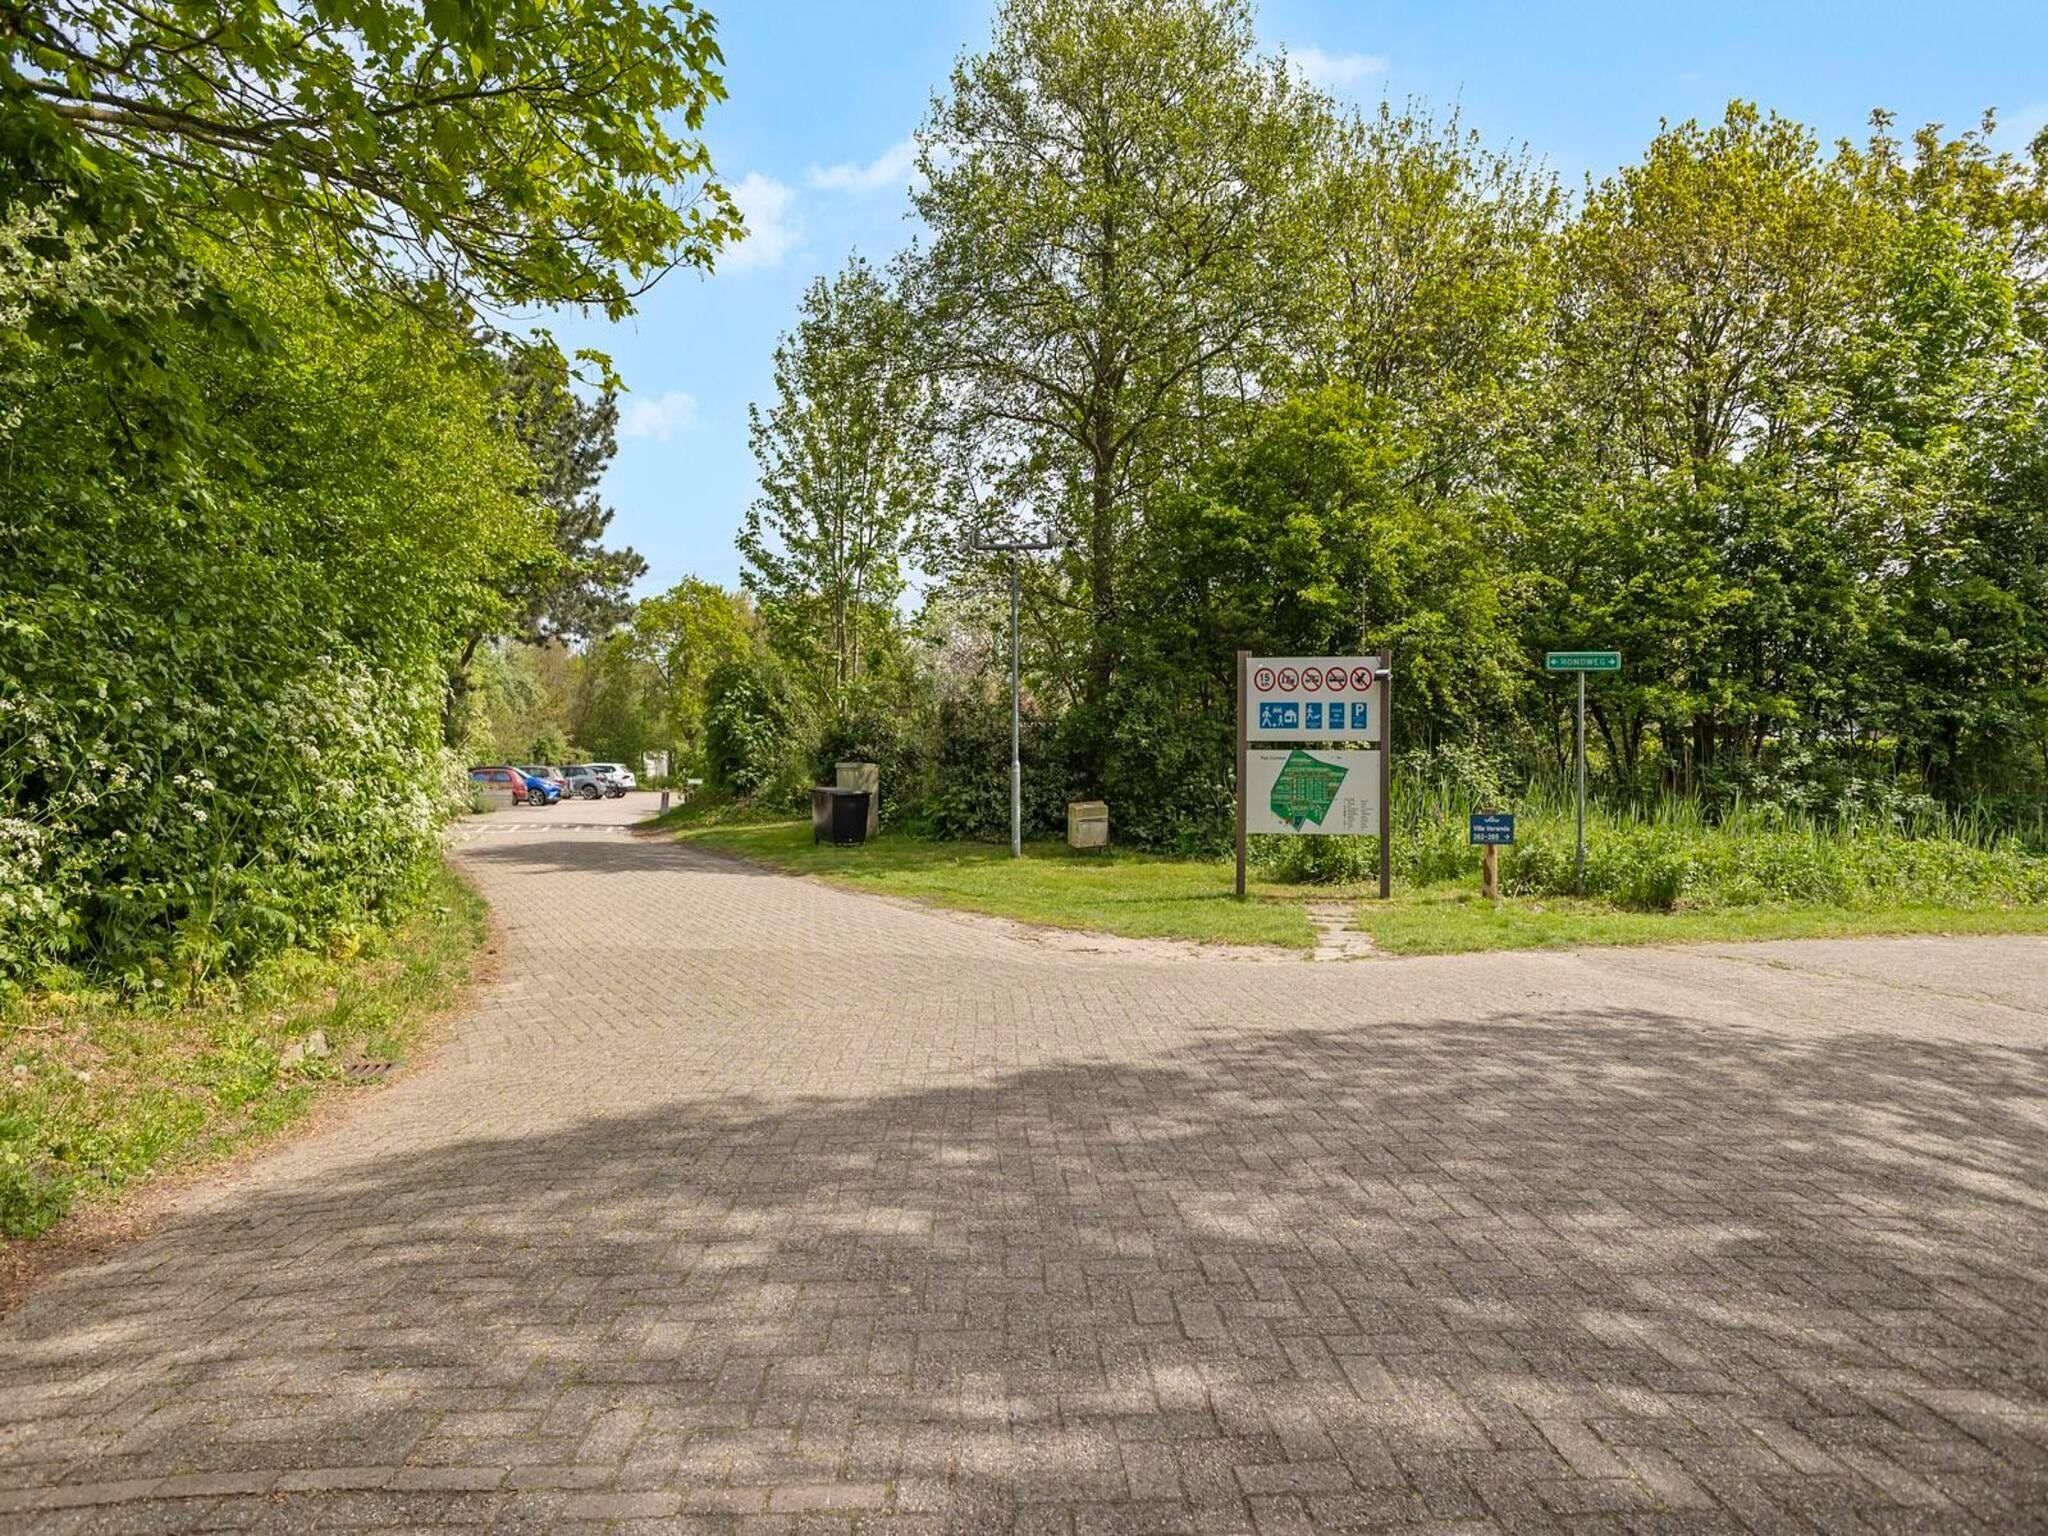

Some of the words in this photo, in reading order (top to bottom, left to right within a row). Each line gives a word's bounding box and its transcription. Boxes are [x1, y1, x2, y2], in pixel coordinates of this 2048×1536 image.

[1560, 657, 1606, 666] RONDWEG
[1260, 673, 1270, 682] 15
[1355, 704, 1364, 716] P
